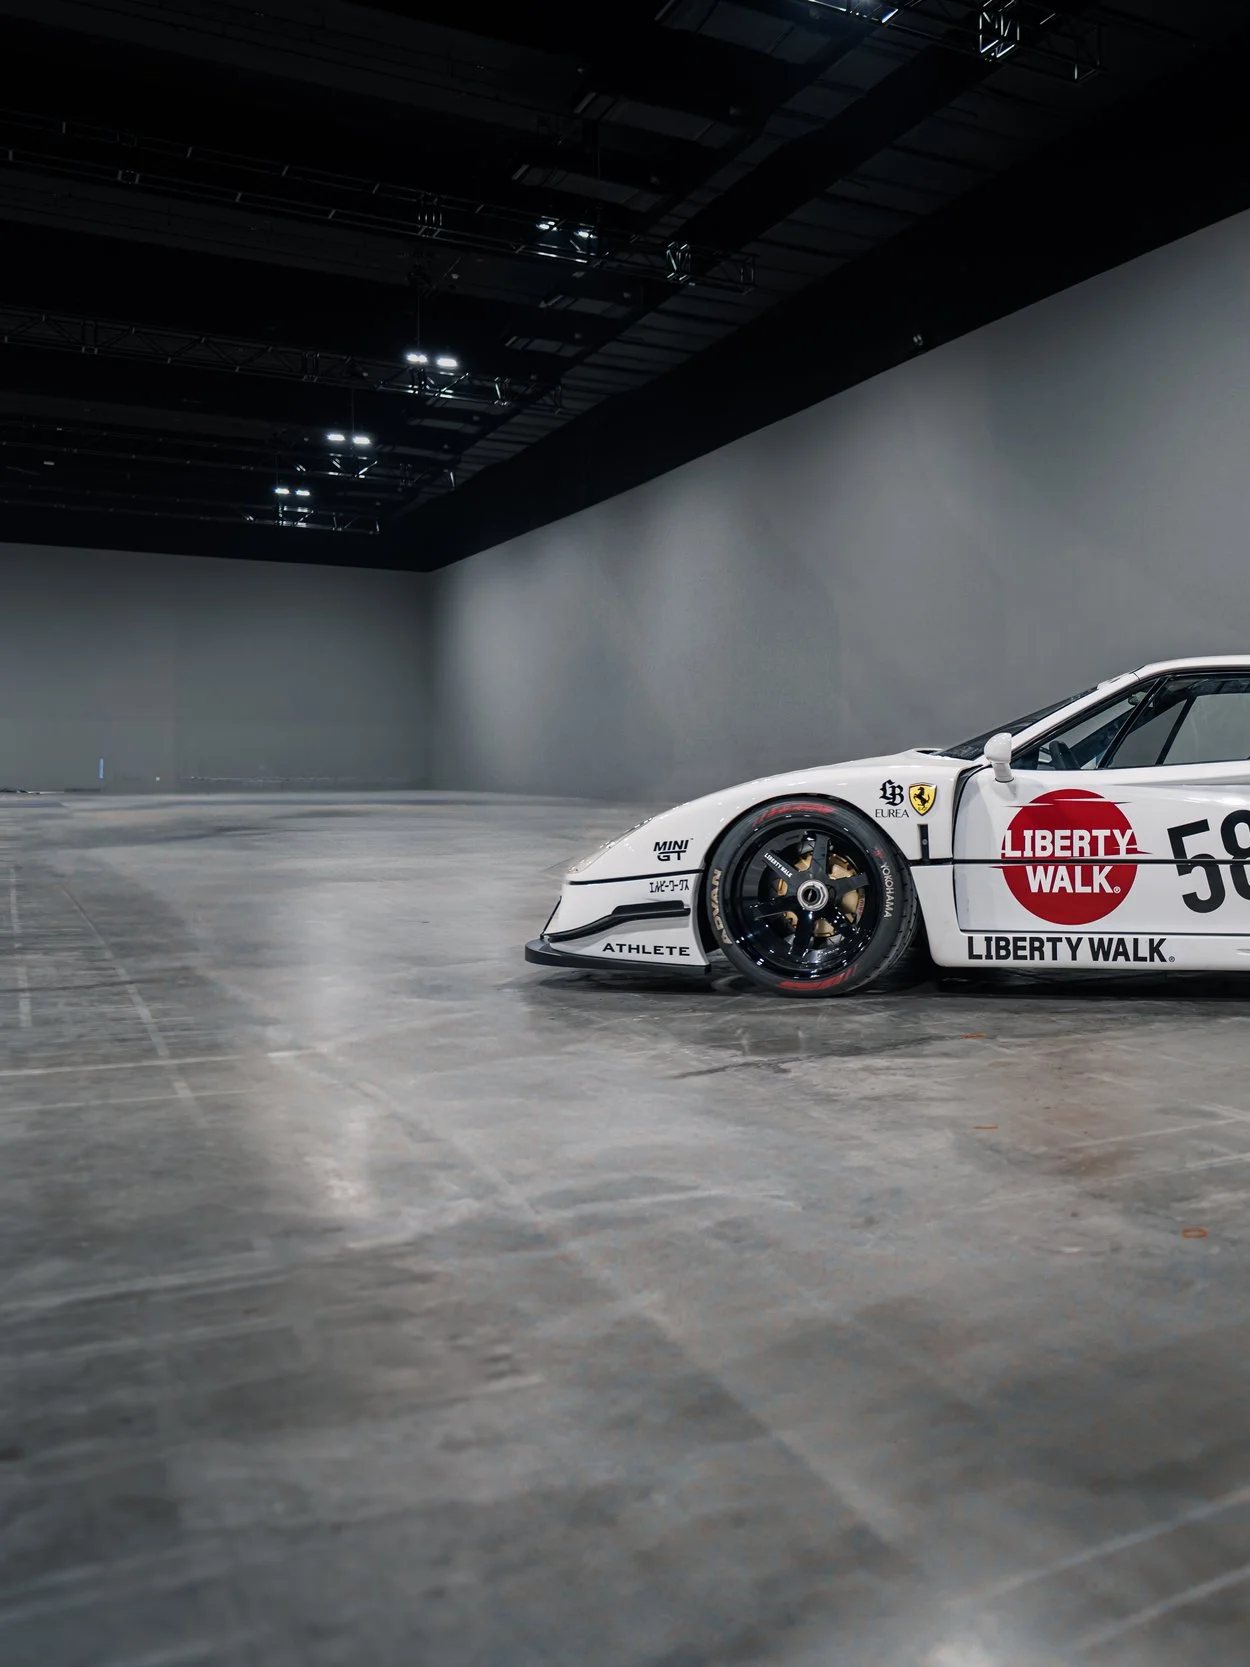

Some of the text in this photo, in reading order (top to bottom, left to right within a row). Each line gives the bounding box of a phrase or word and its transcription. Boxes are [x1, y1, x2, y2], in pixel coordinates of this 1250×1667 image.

[875, 808, 909, 818] EUREA
[653, 839, 689, 852] MINI
[657, 850, 687, 862] GT
[1000, 829, 1134, 858] LIBERTY
[880, 862, 895, 918] YOKOHAMA
[1025, 865, 1114, 894] WALK
[709, 868, 733, 945] ADVAN
[602, 942, 690, 957] ATHLETE
[967, 936, 1167, 962] LIBERTY WALK
